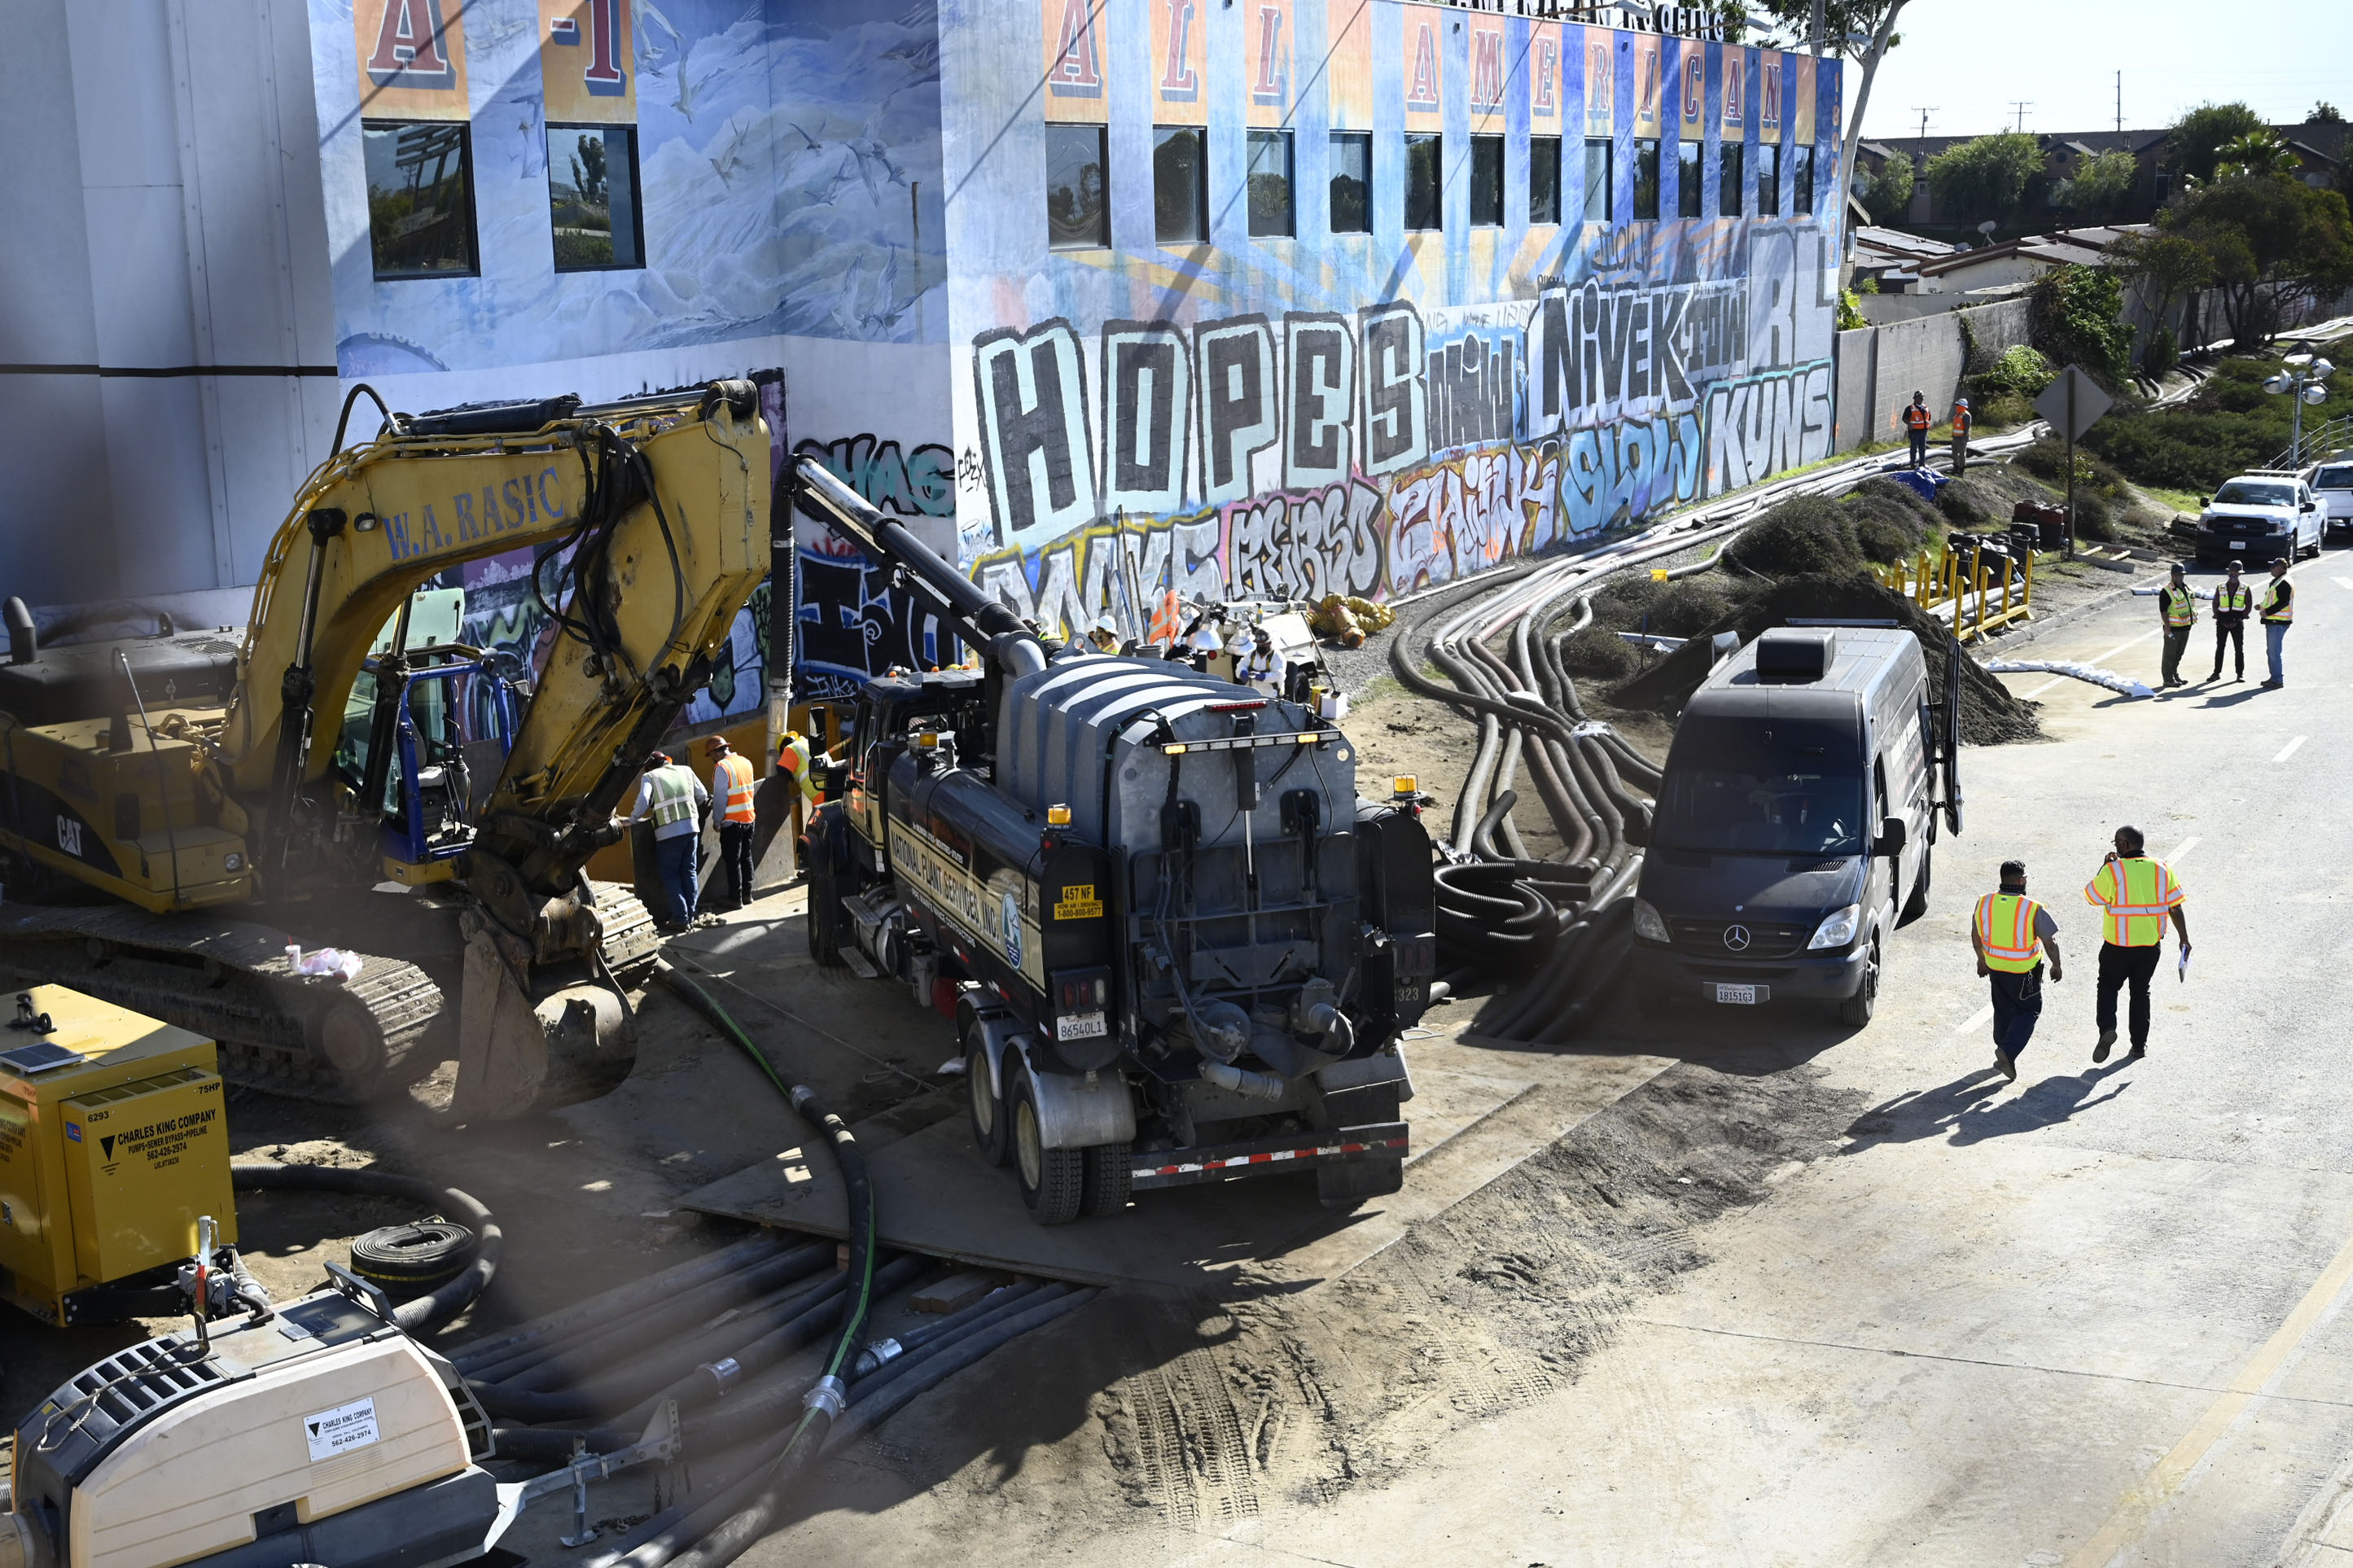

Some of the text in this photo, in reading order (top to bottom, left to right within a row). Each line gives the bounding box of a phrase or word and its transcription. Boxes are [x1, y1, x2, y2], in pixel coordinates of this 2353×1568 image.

[1049, 0, 1284, 106] ALL
[1406, 22, 1781, 132] AMERICAN
[973, 300, 1430, 554] HOPES
[1561, 412, 1704, 536] SLOW
[57, 814, 81, 856] CAT
[891, 830, 921, 878] NATIONAL
[921, 852, 943, 895] PLANT
[983, 900, 1001, 945] INC.
[1064, 887, 1091, 900] 457 NF
[1395, 987, 1419, 1001] 323
[1719, 991, 1753, 1001] 18151G3
[198, 1082, 221, 1094] 75HP
[87, 1110, 110, 1123] 6293
[117, 1108, 217, 1145] CHARLES KING COMPANY
[147, 1141, 187, 1161] 562-426-2974
[322, 1417, 341, 1430] CHARLES
[342, 1413, 353, 1424] KING
[353, 1407, 372, 1420] COMPANY
[331, 1429, 371, 1447] 562-426-2974
